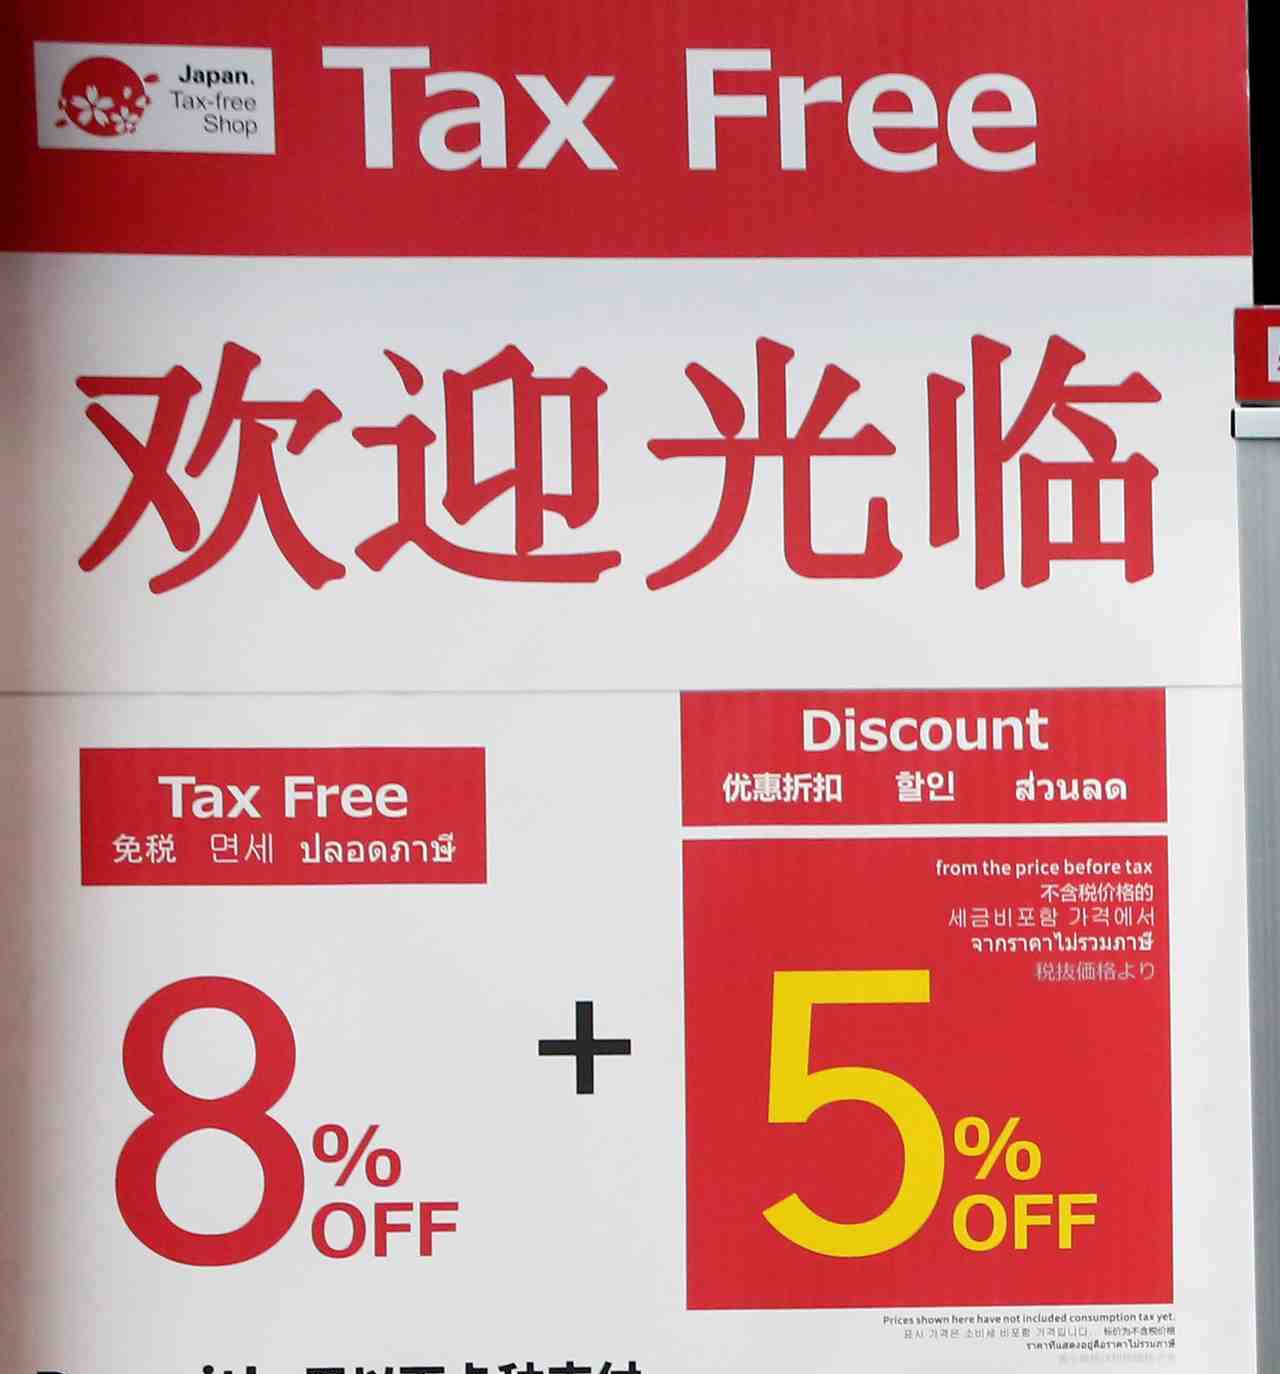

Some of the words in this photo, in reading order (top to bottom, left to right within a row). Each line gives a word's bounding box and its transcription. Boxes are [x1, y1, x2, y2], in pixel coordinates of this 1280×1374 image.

[178, 64, 254, 88] Japan.
[170, 91, 257, 111] Tax-free
[321, 45, 619, 171] Tax
[685, 47, 1038, 173] Free
[203, 114, 258, 139] Shop
[73, 333, 1163, 595] 欢迎光临
[802, 707, 1049, 753] Discount
[157, 775, 262, 819] Tax
[284, 775, 408, 818] Free
[722, 771, 842, 804] 优惠折扣
[895, 770, 955, 803] 할인
[1015, 769, 1128, 802] ส่วนลด
[112, 833, 177, 864] 免税
[210, 832, 273, 864] 면세
[300, 831, 457, 864] ปลอดภาษี
[935, 859, 978, 876] from
[982, 859, 1012, 876] the
[1015, 858, 1060, 879] price
[1063, 858, 1121, 875] before
[1125, 859, 1153, 875] tax
[114, 975, 305, 1267] 8
[762, 969, 946, 1259] 5
[311, 1201, 459, 1259] OFF
[951, 1191, 1100, 1253] OFF
